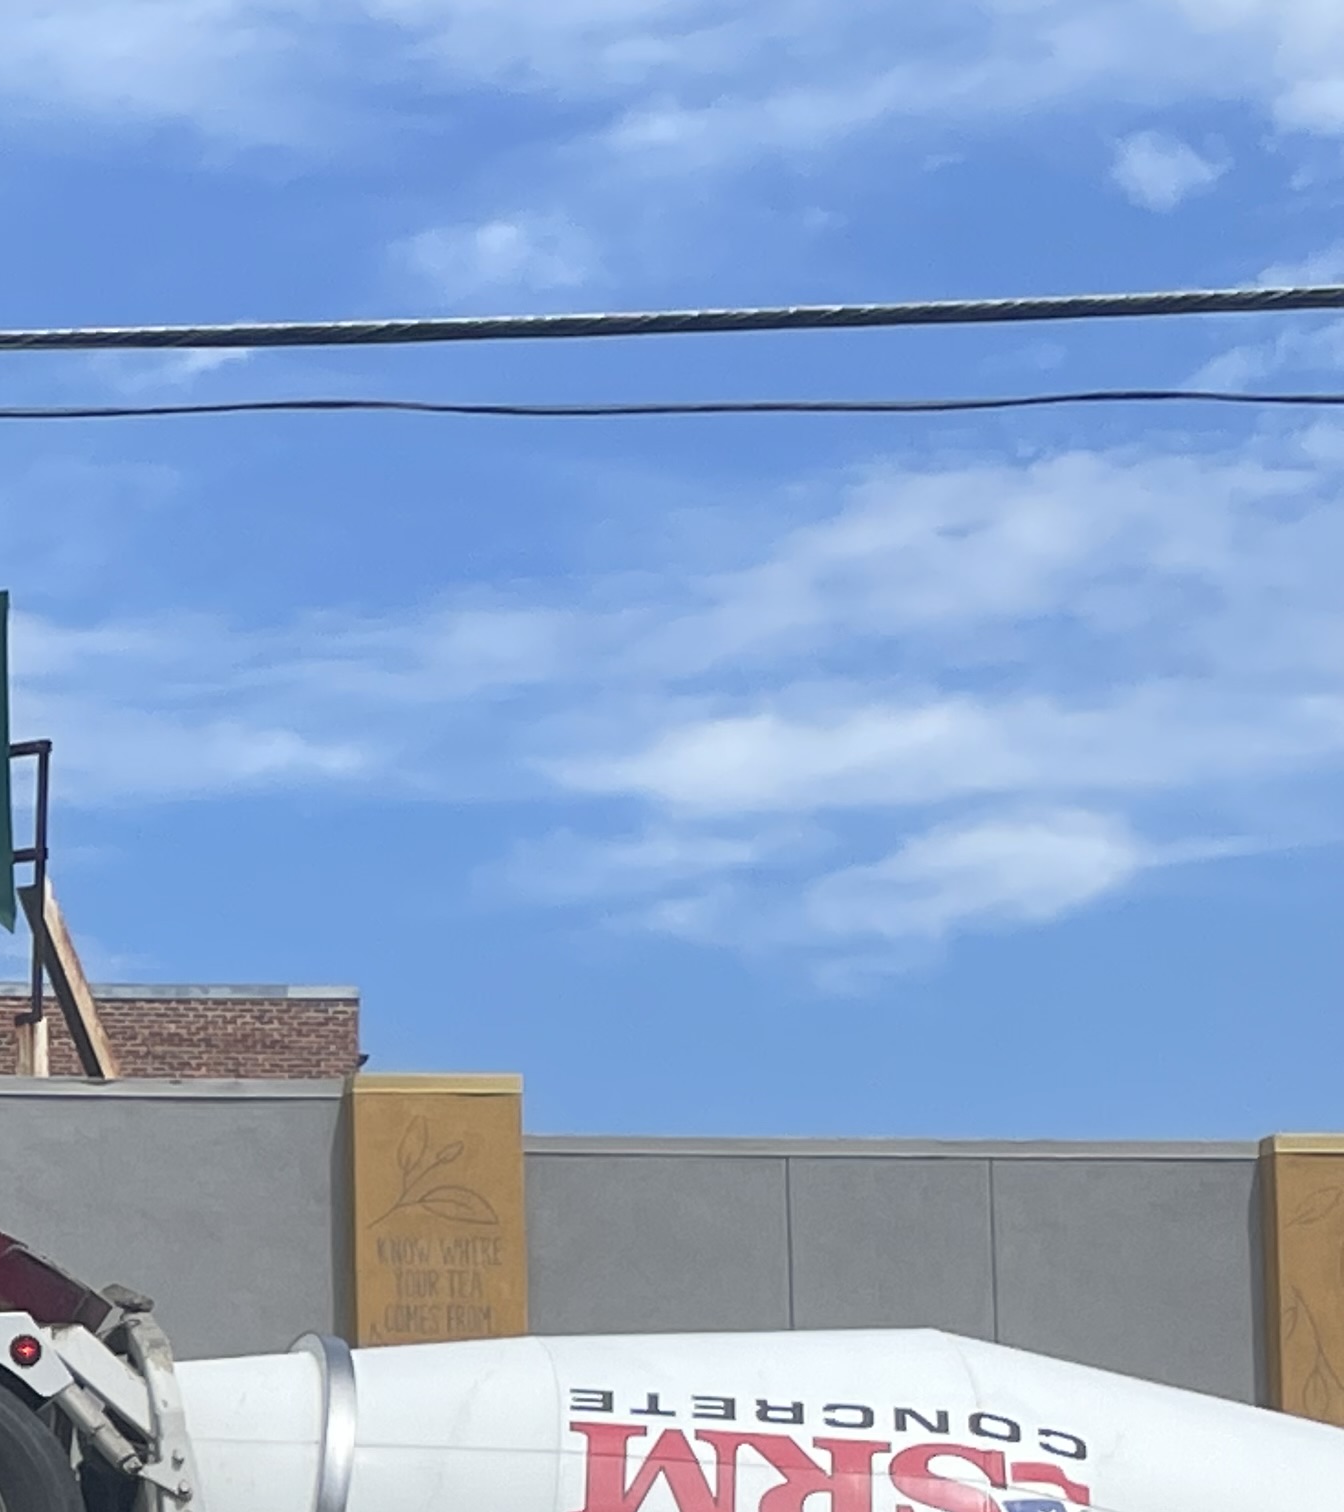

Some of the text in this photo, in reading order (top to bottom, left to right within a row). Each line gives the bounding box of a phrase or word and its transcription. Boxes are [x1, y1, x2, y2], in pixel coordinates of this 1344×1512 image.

[377, 1236, 503, 1266] KNOW WHERE
[394, 1269, 484, 1298] YOUR TEA
[447, 1304, 493, 1334] FROM
[569, 1388, 1088, 1461] CONCRETE
